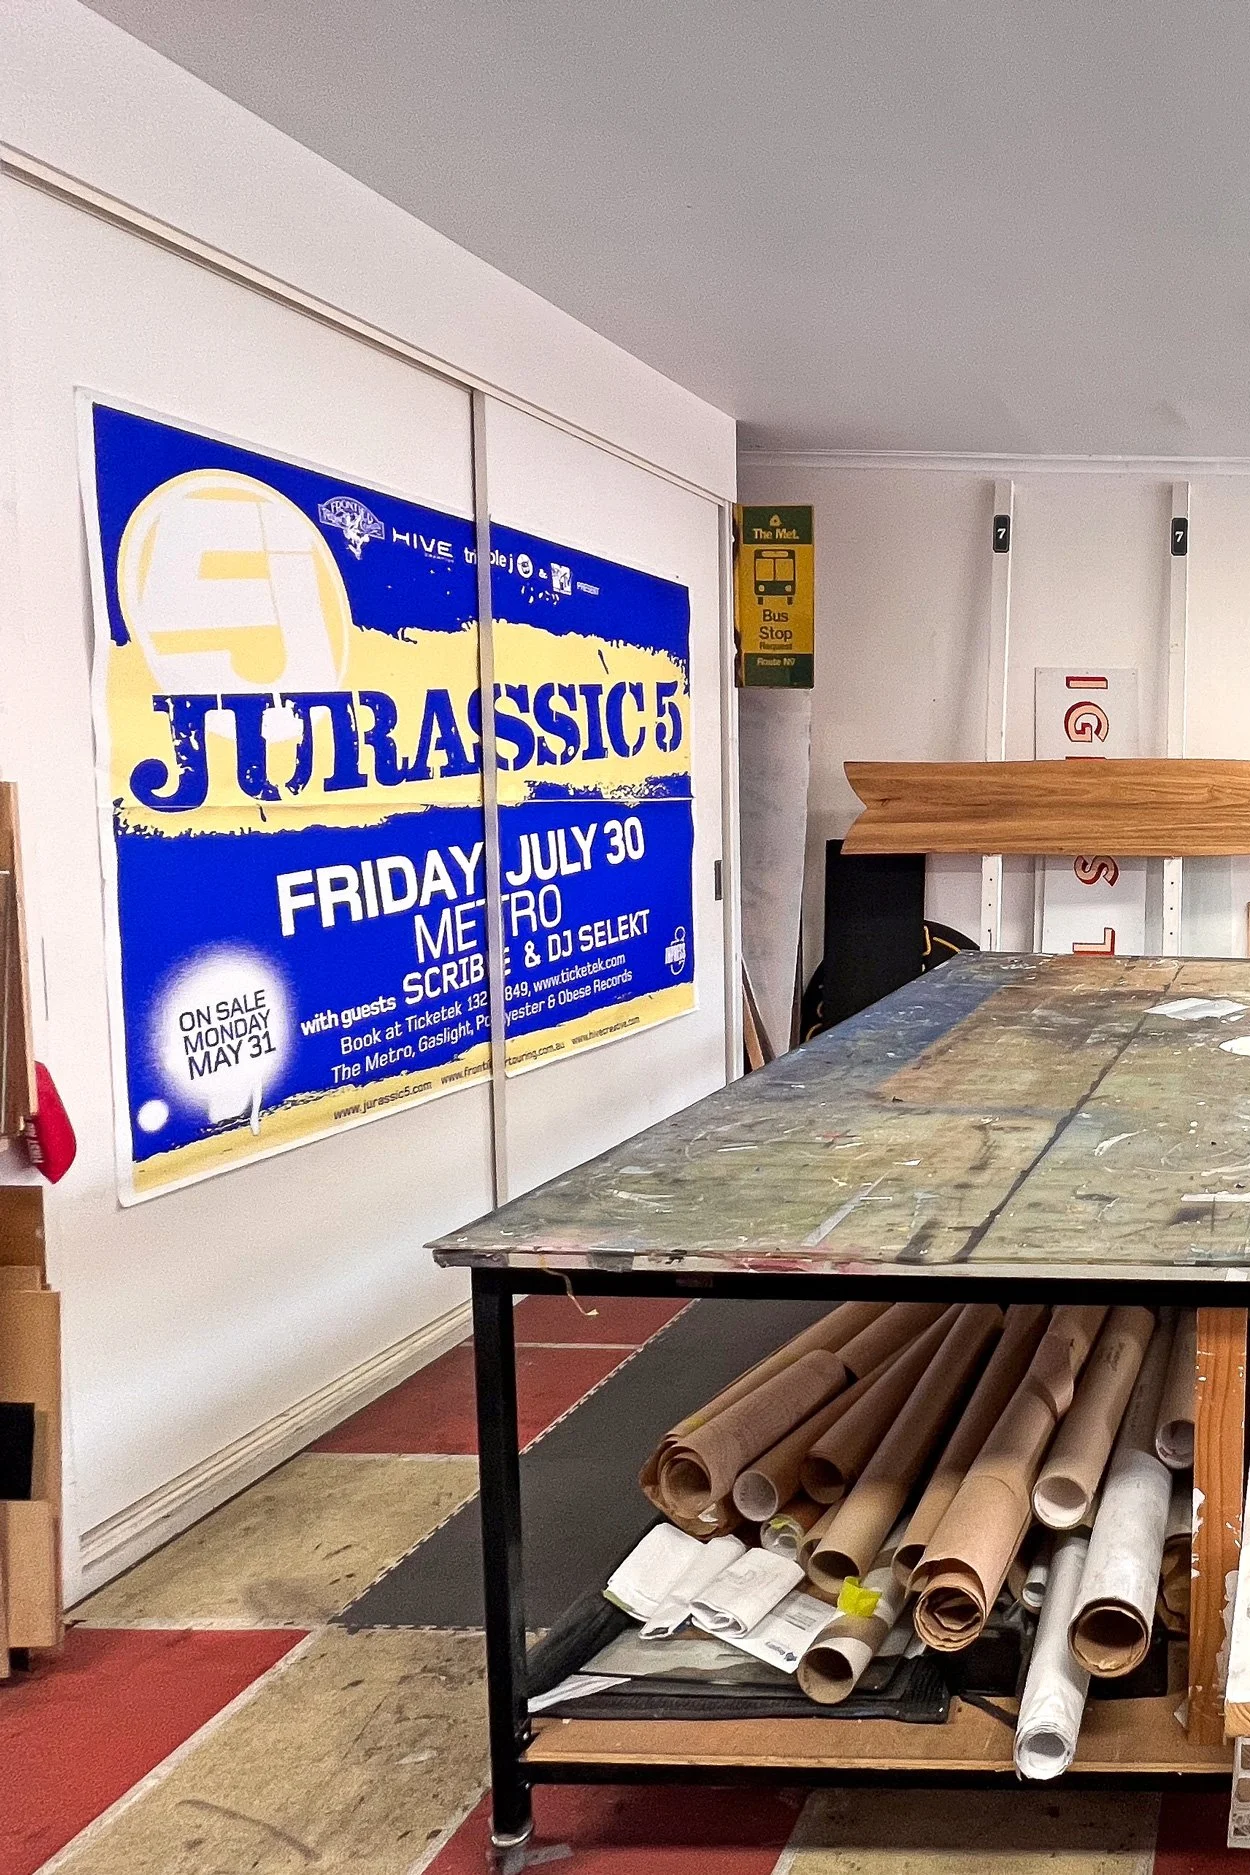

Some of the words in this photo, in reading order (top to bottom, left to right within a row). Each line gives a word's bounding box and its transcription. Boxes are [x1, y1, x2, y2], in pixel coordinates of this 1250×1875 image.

[392, 527, 453, 558] HIVE
[752, 528, 772, 540] The
[997, 528, 1007, 540] 7
[1174, 531, 1184, 543] 7
[759, 626, 793, 642] Stop
[763, 609, 789, 622] Bus
[130, 682, 646, 813] JURASSIC
[656, 681, 683, 756] 5
[276, 842, 484, 938] FRIDAY
[505, 823, 598, 887] JULY
[605, 816, 645, 865] 30
[300, 1009, 340, 1036] with
[341, 996, 397, 1029] guests
[524, 940, 541, 968] &
[548, 929, 573, 962] DJ
[578, 909, 651, 952] SELEKT
[179, 1005, 212, 1032] ON
[215, 989, 267, 1022] SALE
[331, 1063, 361, 1084] The
[365, 1043, 416, 1073] Metro,
[418, 1020, 474, 1053] Gaslight,
[476, 999, 546, 1031] Poyester
[558, 985, 592, 1006] Obese
[593, 968, 633, 994] Records
[341, 1026, 382, 1055] Book
[385, 1021, 402, 1041] at
[405, 1000, 463, 1033] Ticketek
[467, 990, 488, 1012] 132
[505, 981, 532, 1003] 849,
[533, 953, 626, 994] www.ticketek.com
[183, 1009, 271, 1056] MONDAY
[188, 1040, 243, 1081] MAY
[248, 1030, 277, 1059] 31
[333, 1080, 433, 1121] www.jurassic5.com
[440, 1040, 566, 1085] www.frontirtouring.com.au
